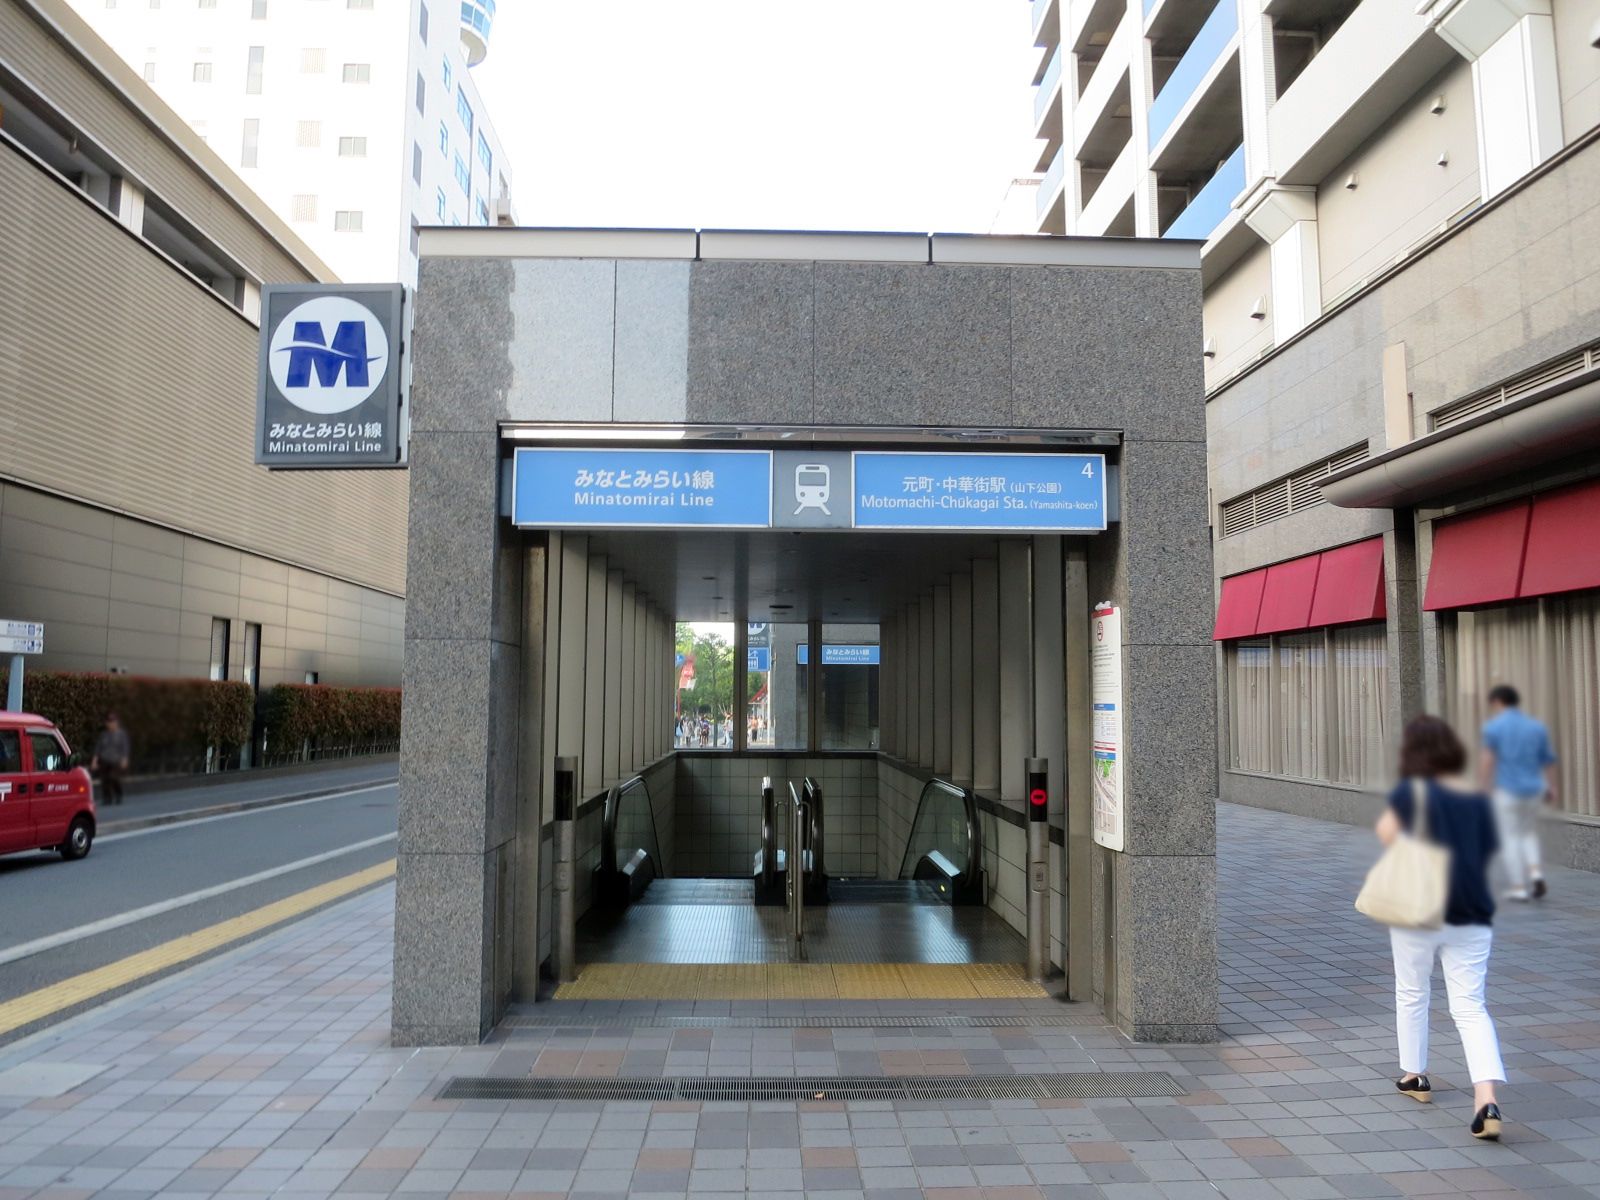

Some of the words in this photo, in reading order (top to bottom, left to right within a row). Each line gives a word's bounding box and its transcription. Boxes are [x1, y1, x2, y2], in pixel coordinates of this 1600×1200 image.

[270, 422, 382, 439] みなとみらい線
[269, 441, 350, 453] Minatomirai
[355, 441, 381, 452] Line
[1081, 462, 1095, 479] 4
[574, 470, 715, 489] みなとみらい線
[902, 476, 1006, 494] 元町・中華街駅
[574, 492, 674, 506] Minatomirai
[680, 493, 714, 506] Line
[1003, 496, 1028, 509] Sta.
